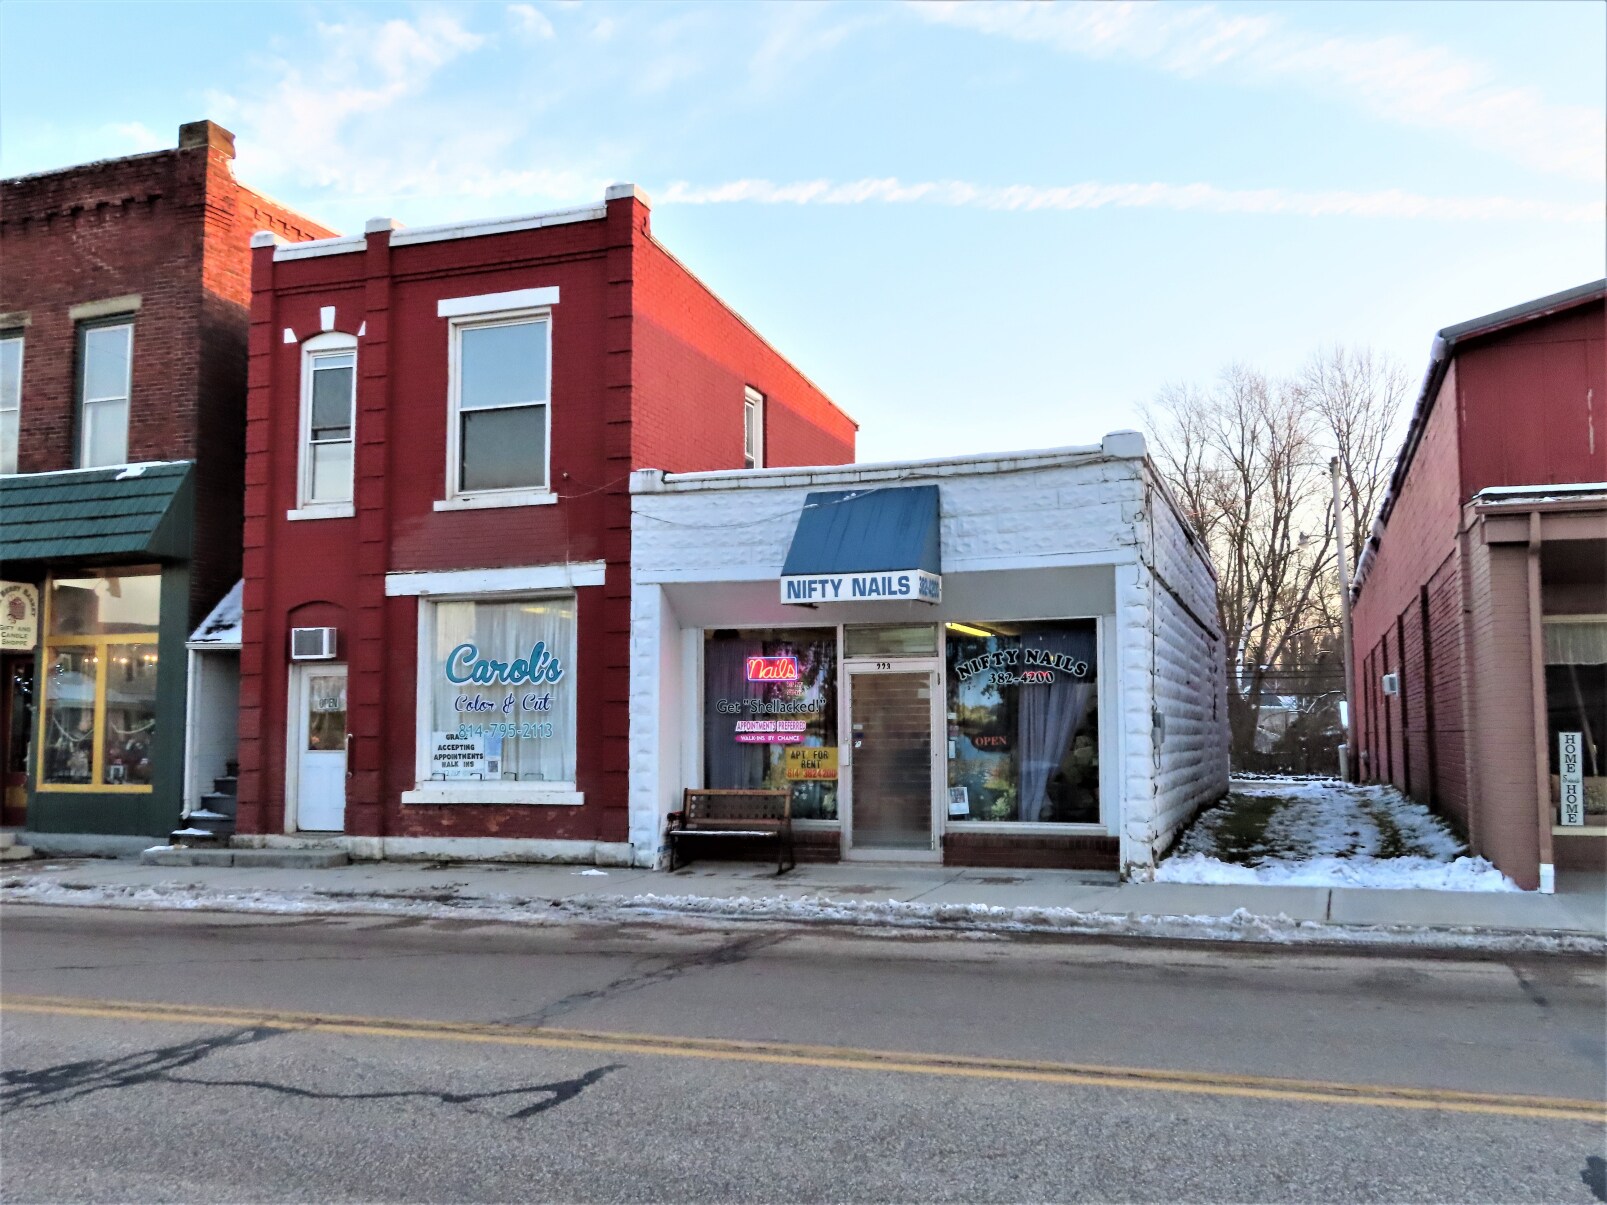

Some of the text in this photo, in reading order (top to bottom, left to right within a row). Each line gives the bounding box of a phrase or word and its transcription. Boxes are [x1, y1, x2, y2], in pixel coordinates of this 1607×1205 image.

[787, 575, 911, 599] NIFTY NAILS
[445, 641, 563, 684] Carol's
[956, 649, 1088, 680] NIFTY NAILS
[989, 671, 1054, 684] 382-4200
[318, 698, 338, 709] OPEN
[454, 692, 555, 714] Color & Cut
[717, 699, 741, 713] Get
[458, 723, 553, 738] 814-795-2113
[735, 720, 807, 731] APPOINTMENTS PREFERRED
[975, 736, 1008, 746] OPEN
[790, 750, 829, 760] APT FOR
[1564, 734, 1577, 773] HOME
[801, 759, 822, 769] RENT
[1565, 784, 1578, 823] HOME
